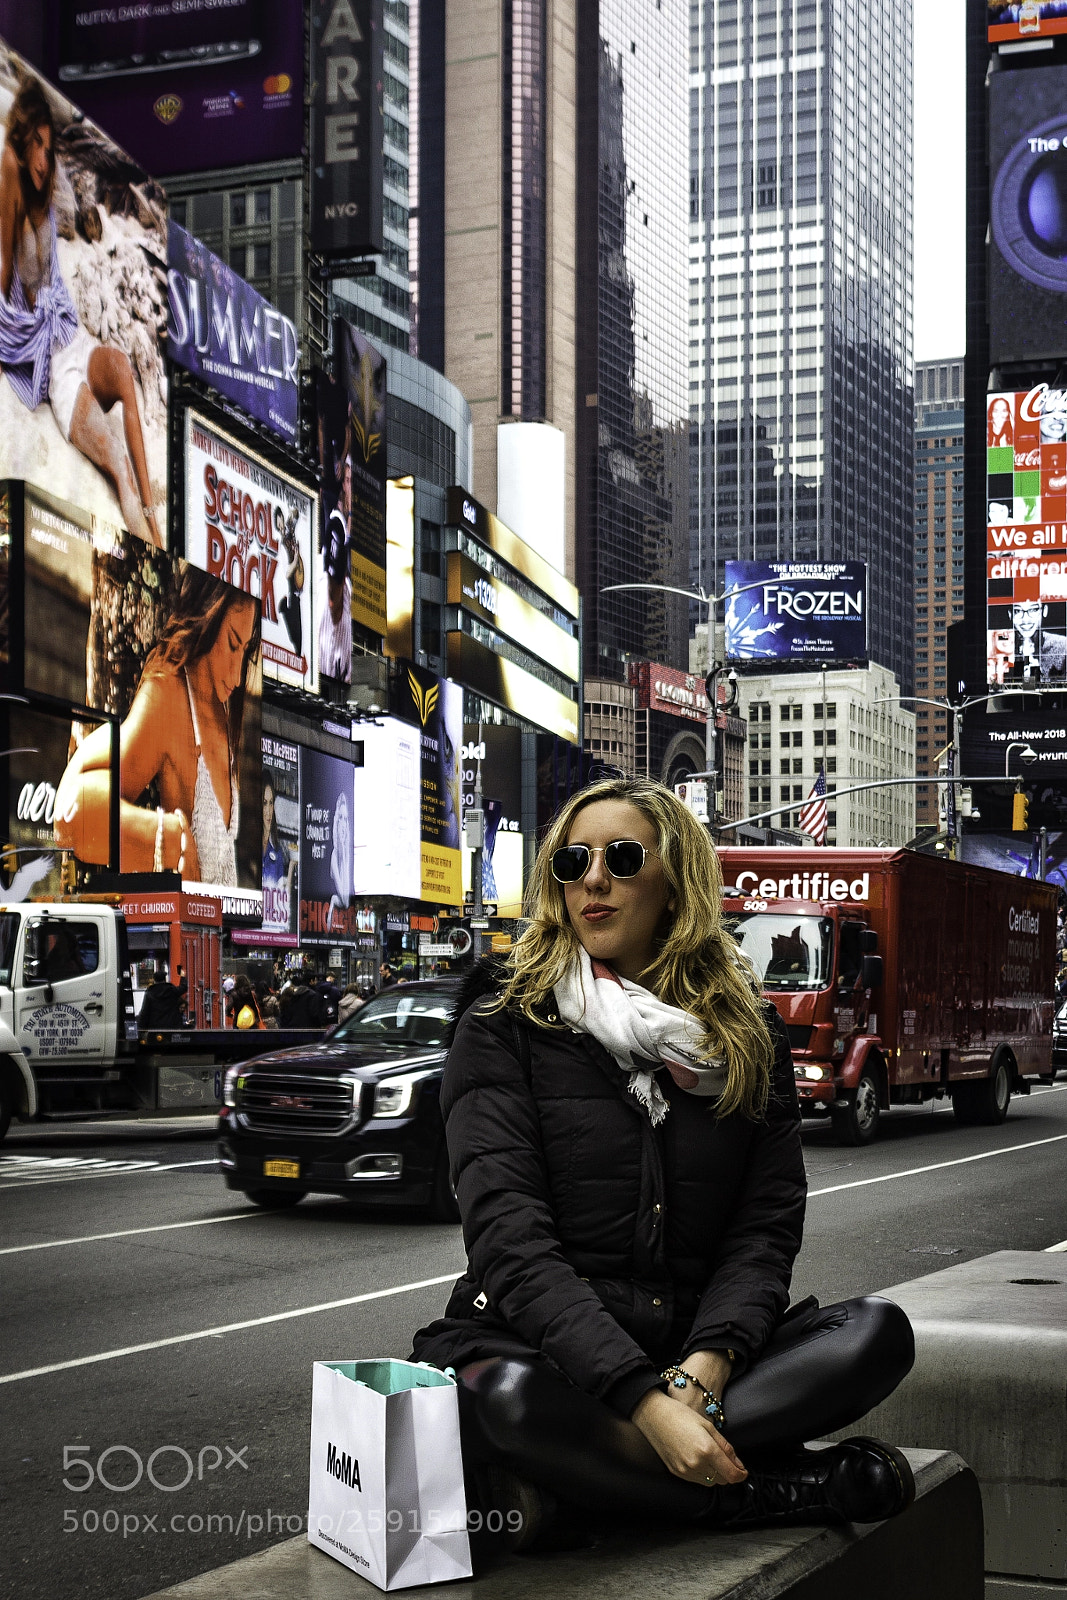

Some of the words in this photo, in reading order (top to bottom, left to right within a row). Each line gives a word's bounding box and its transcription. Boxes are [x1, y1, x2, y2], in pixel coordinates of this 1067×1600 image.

[118, 4, 151, 21] DARK
[1028, 137, 1060, 153] The
[324, 202, 359, 220] NYC
[167, 268, 301, 387] SUMMER
[202, 358, 213, 372] THE
[214, 361, 233, 378] DONNA
[234, 367, 254, 384] SUMMER
[255, 373, 275, 391] MUSICAL
[203, 464, 280, 557] SCHOOL
[237, 529, 250, 568] of
[991, 528, 1027, 547] We
[1032, 525, 1056, 545] all
[206, 522, 280, 627] ROCK
[788, 563, 821, 573] HOTTEST
[823, 563, 846, 573] SHOW
[763, 585, 862, 621] FROZEN
[988, 731, 1006, 742] The
[1007, 730, 1042, 741] All-New
[1044, 729, 1067, 739] 2018
[273, 742, 297, 763] McPHEE
[460, 741, 486, 760] old
[17, 781, 78, 824] aere
[735, 871, 870, 901] Certified
[140, 902, 175, 914] CHURROS
[187, 902, 216, 918] COFFEED
[300, 899, 356, 937] CHICAGO
[743, 900, 768, 911] 509
[1008, 906, 1040, 934] Certified
[1007, 939, 1033, 963] moving
[1002, 961, 1030, 989] storage
[23, 1017, 36, 1033] TRI
[32, 1004, 54, 1021] STATE
[54, 1002, 91, 1031] AUTOMOTIVE
[34, 1029, 45, 1038] NEW
[326, 1441, 362, 1493] MoMA
